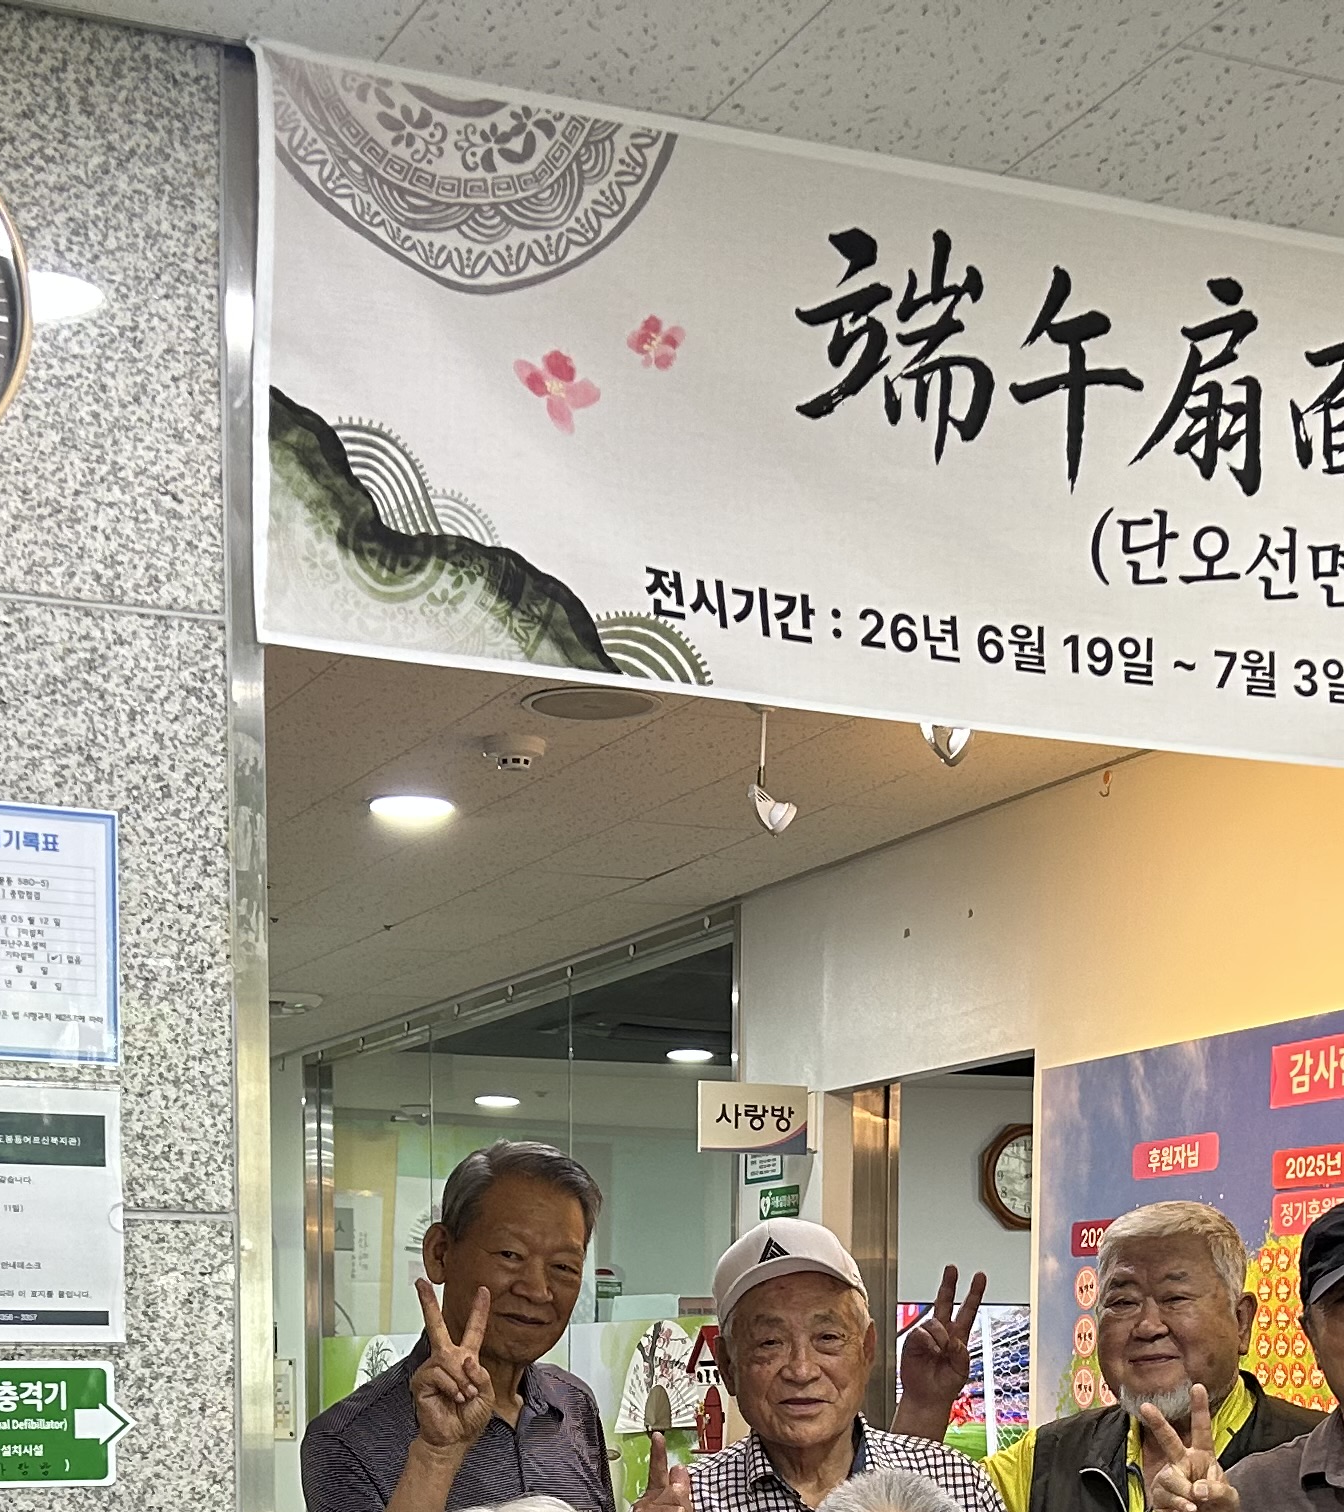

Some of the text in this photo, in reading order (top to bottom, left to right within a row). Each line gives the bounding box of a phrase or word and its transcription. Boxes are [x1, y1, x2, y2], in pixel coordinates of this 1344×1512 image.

[644, 565, 815, 645] 전시기간
[859, 608, 961, 664] 26년
[977, 624, 1046, 675] 6월
[1063, 634, 1154, 686] 19일
[1214, 649, 1276, 698] 7월
[716, 1103, 795, 1132] 사랑방
[1147, 1142, 1199, 1173] 후원자님
[1285, 1151, 1342, 1179] 2025년
[0, 1444, 44, 1458] 설치시설
